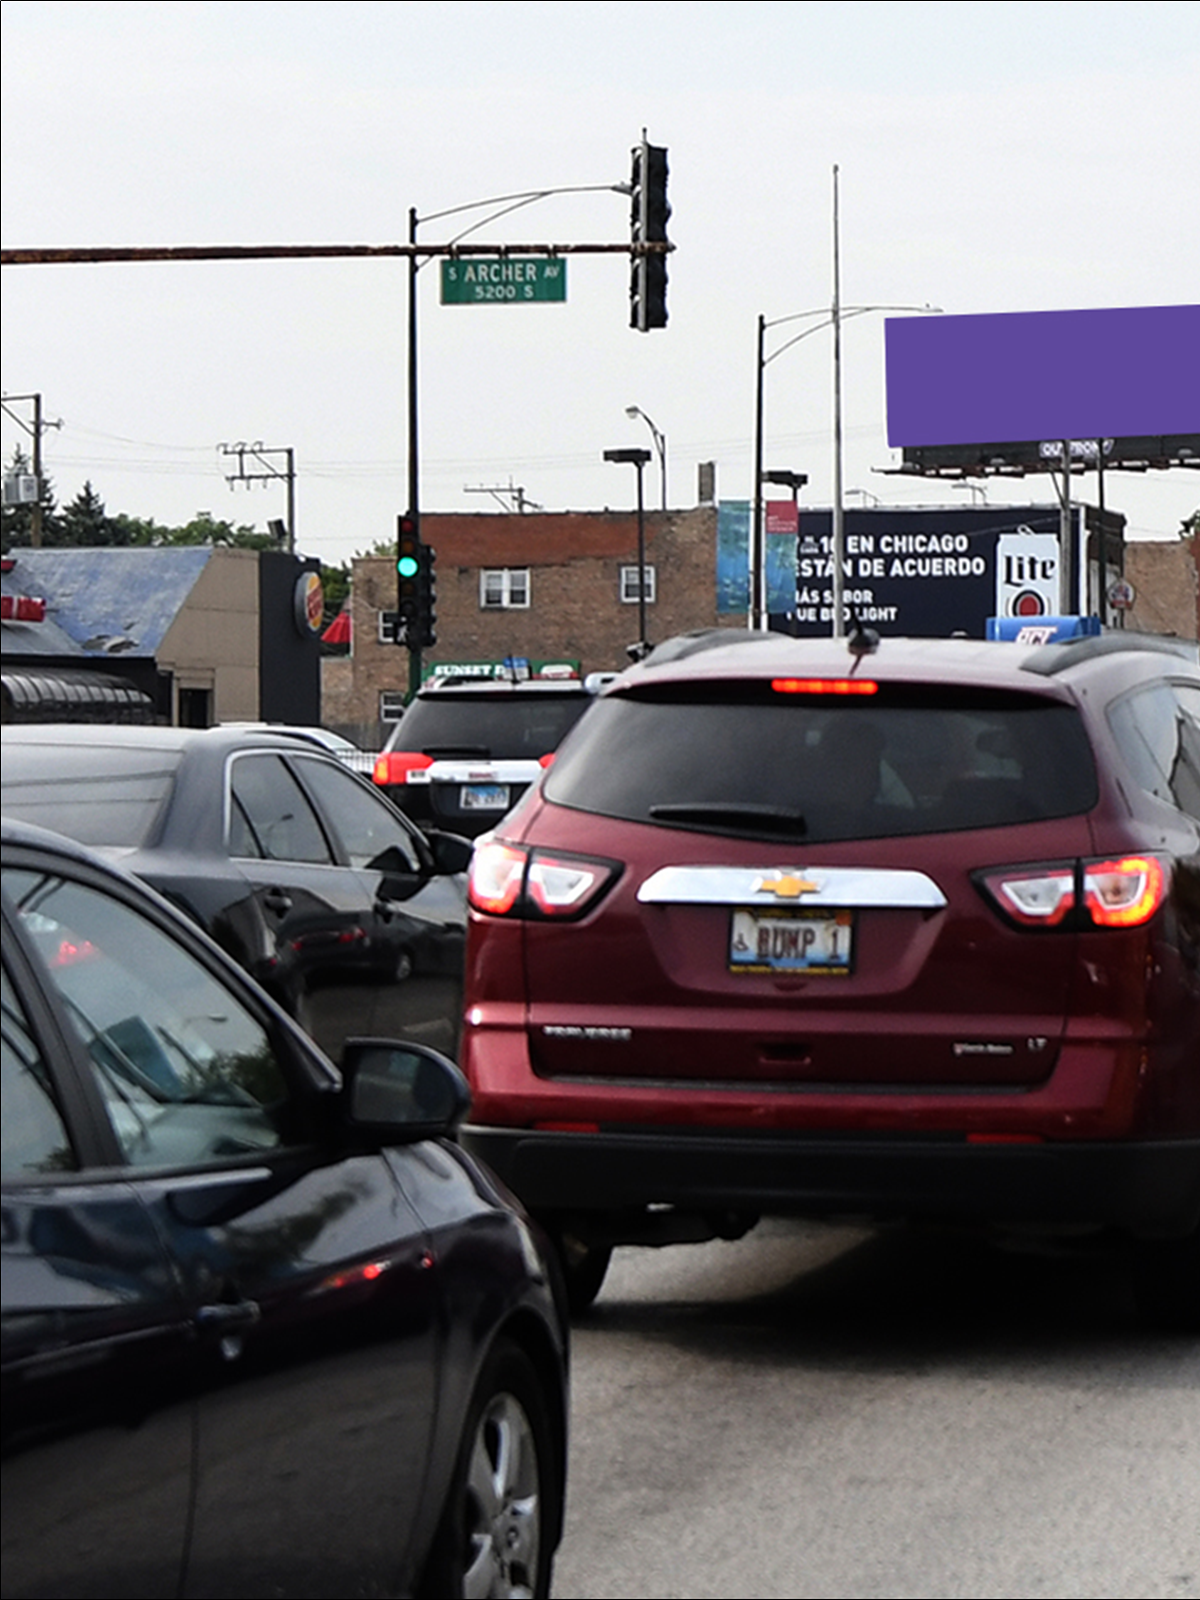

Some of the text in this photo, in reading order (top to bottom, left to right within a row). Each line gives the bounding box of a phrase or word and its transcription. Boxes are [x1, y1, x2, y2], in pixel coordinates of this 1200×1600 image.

[449, 263, 560, 282] S ARCHER AV
[475, 285, 534, 299] 5200 S
[847, 535, 874, 553] EN
[879, 534, 968, 553] CHICAGO
[858, 558, 886, 577] DE
[889, 557, 986, 577] ACUERDO
[1003, 555, 1056, 588] Lite
[823, 589, 874, 604] SBOR
[434, 664, 492, 677] SUNSET
[757, 926, 816, 960] BUMP
